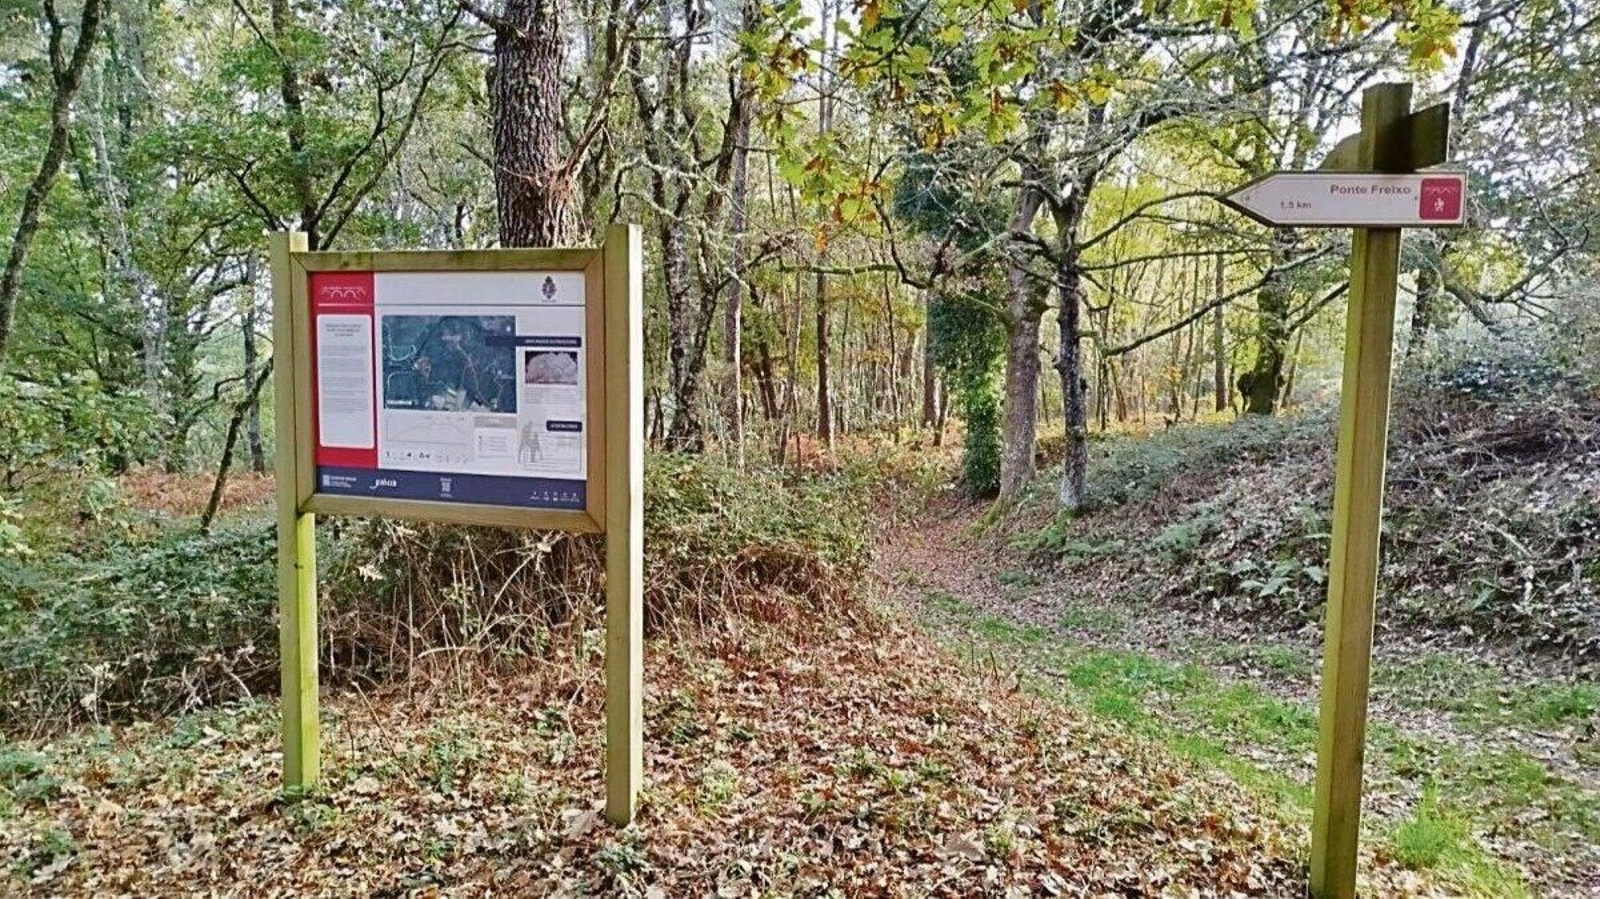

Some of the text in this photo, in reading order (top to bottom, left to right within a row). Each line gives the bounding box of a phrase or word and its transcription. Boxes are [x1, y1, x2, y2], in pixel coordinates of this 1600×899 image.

[1330, 184, 1411, 194] Ponte Freixo
[1296, 201, 1312, 209] km
